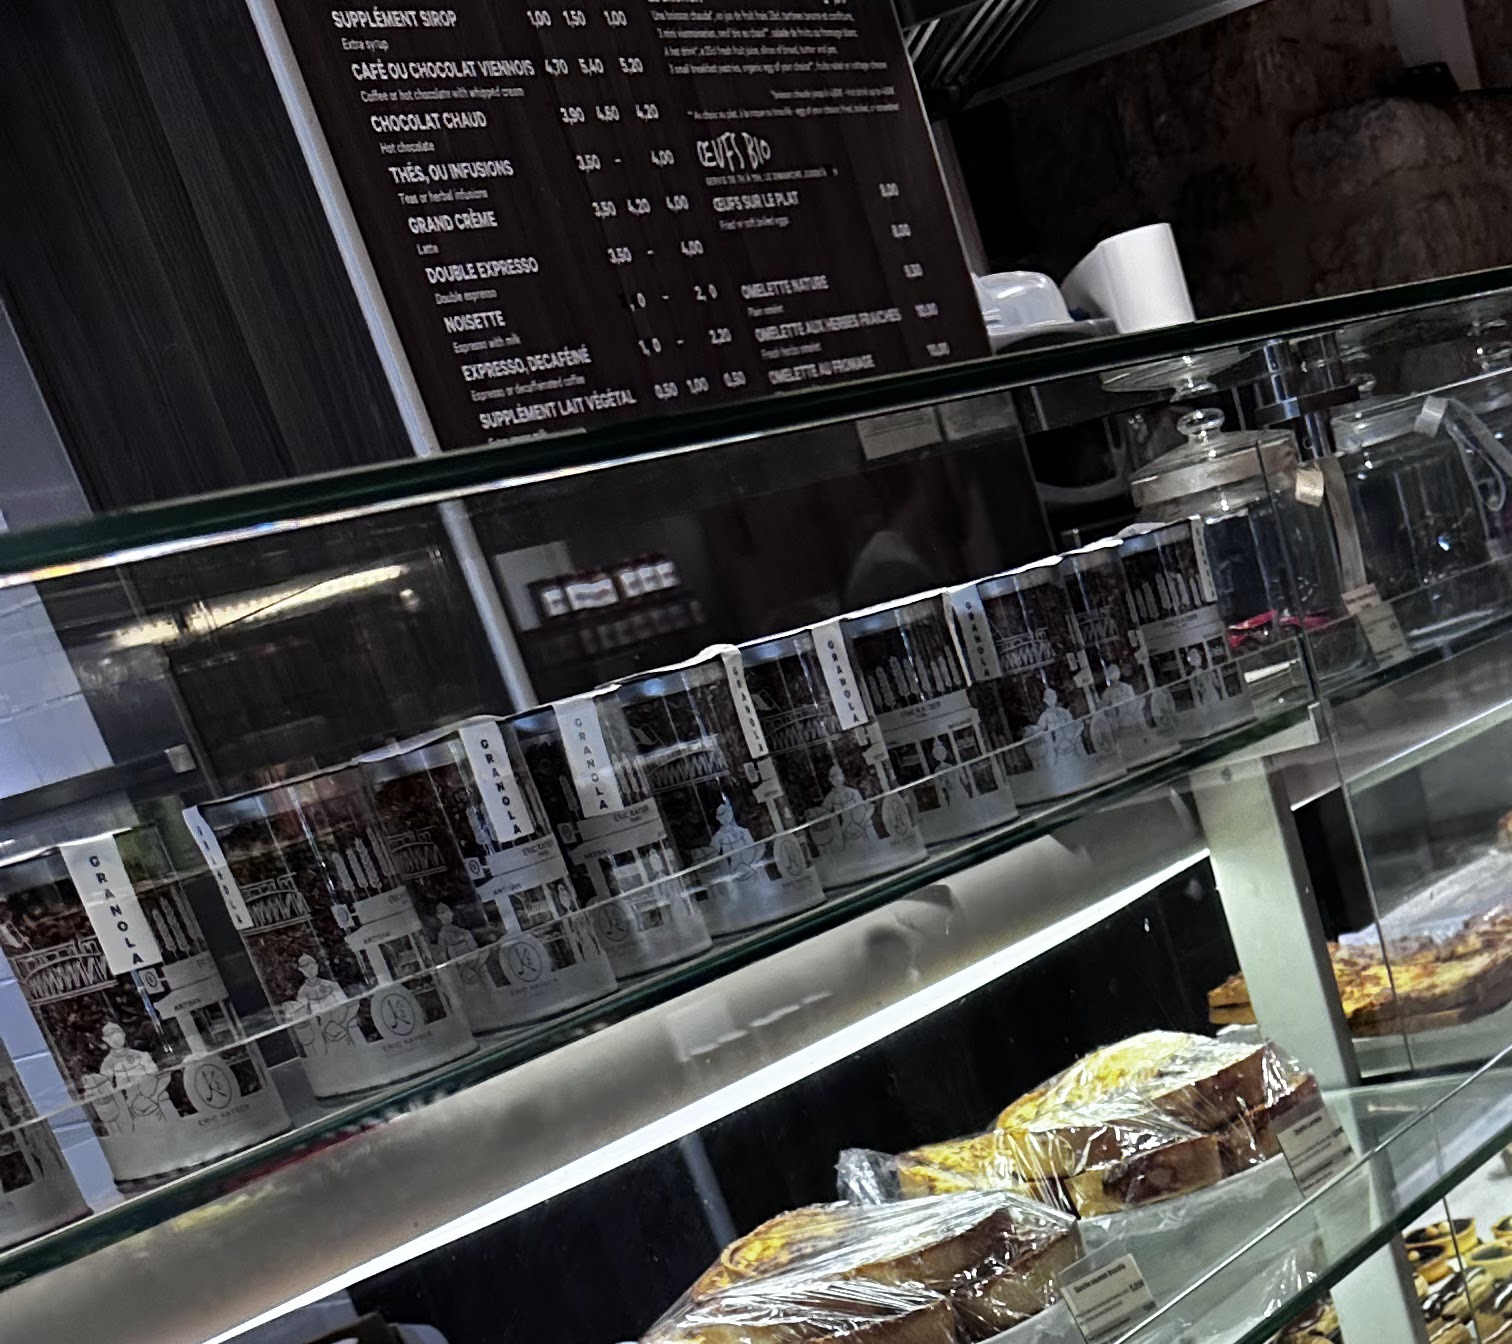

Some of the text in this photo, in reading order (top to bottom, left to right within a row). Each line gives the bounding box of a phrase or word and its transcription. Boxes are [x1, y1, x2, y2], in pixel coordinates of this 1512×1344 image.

[331, 7, 457, 28] SUPPLÉMENT SIROP
[527, 10, 628, 29] 1,00 1,50 1,00
[351, 60, 535, 81] CAFÉ OU CHOCOLAT VIENNOIS
[578, 58, 604, 77] 5,40
[618, 57, 644, 75] 5,20
[370, 111, 487, 132] CHOCOLAT CHAUD
[559, 106, 585, 125] 3,90
[742, 132, 771, 169] BIO
[388, 160, 514, 184] THÉS, OU INFUSIONS
[407, 208, 498, 235] GRAND CRÈME
[425, 257, 540, 284] DOUBLE EXPRESSO
[741, 280, 791, 300] OMELETTE
[443, 310, 506, 334] NOISETTE
[461, 358, 529, 382] EXPRESSO,
[479, 387, 637, 430] SUPPLÉMENT LAIT VÉGÉTAL
[827, 640, 861, 723] GRANOLA
[574, 717, 609, 811] GRANOLA
[480, 739, 523, 835] GRANOLA
[89, 855, 145, 966] GRANOLA
